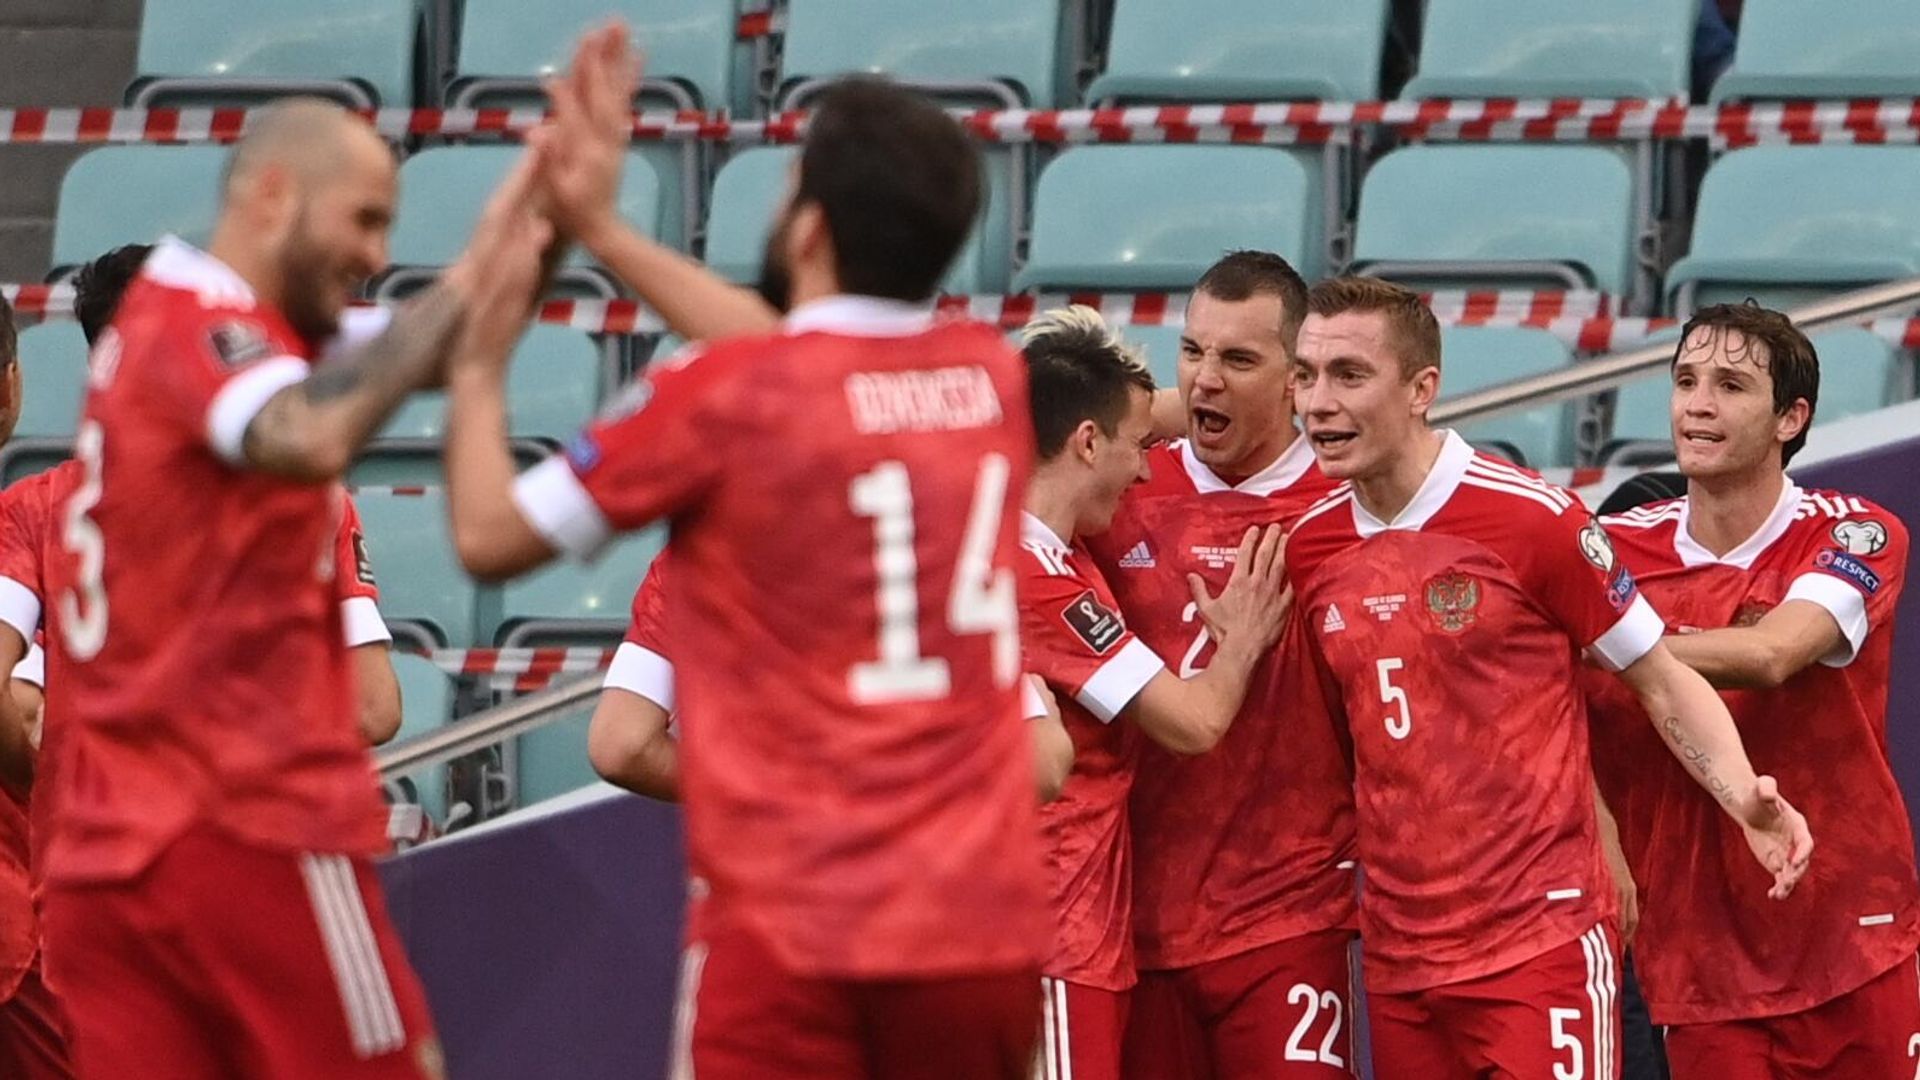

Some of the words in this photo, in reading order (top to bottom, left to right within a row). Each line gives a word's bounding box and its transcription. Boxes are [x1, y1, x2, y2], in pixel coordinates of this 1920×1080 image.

[849, 454, 1020, 703] 14
[1833, 556, 1879, 590] RESPECT
[1376, 657, 1411, 740] 5
[1284, 983, 1344, 1069] 22
[1549, 1007, 1584, 1080] 5
